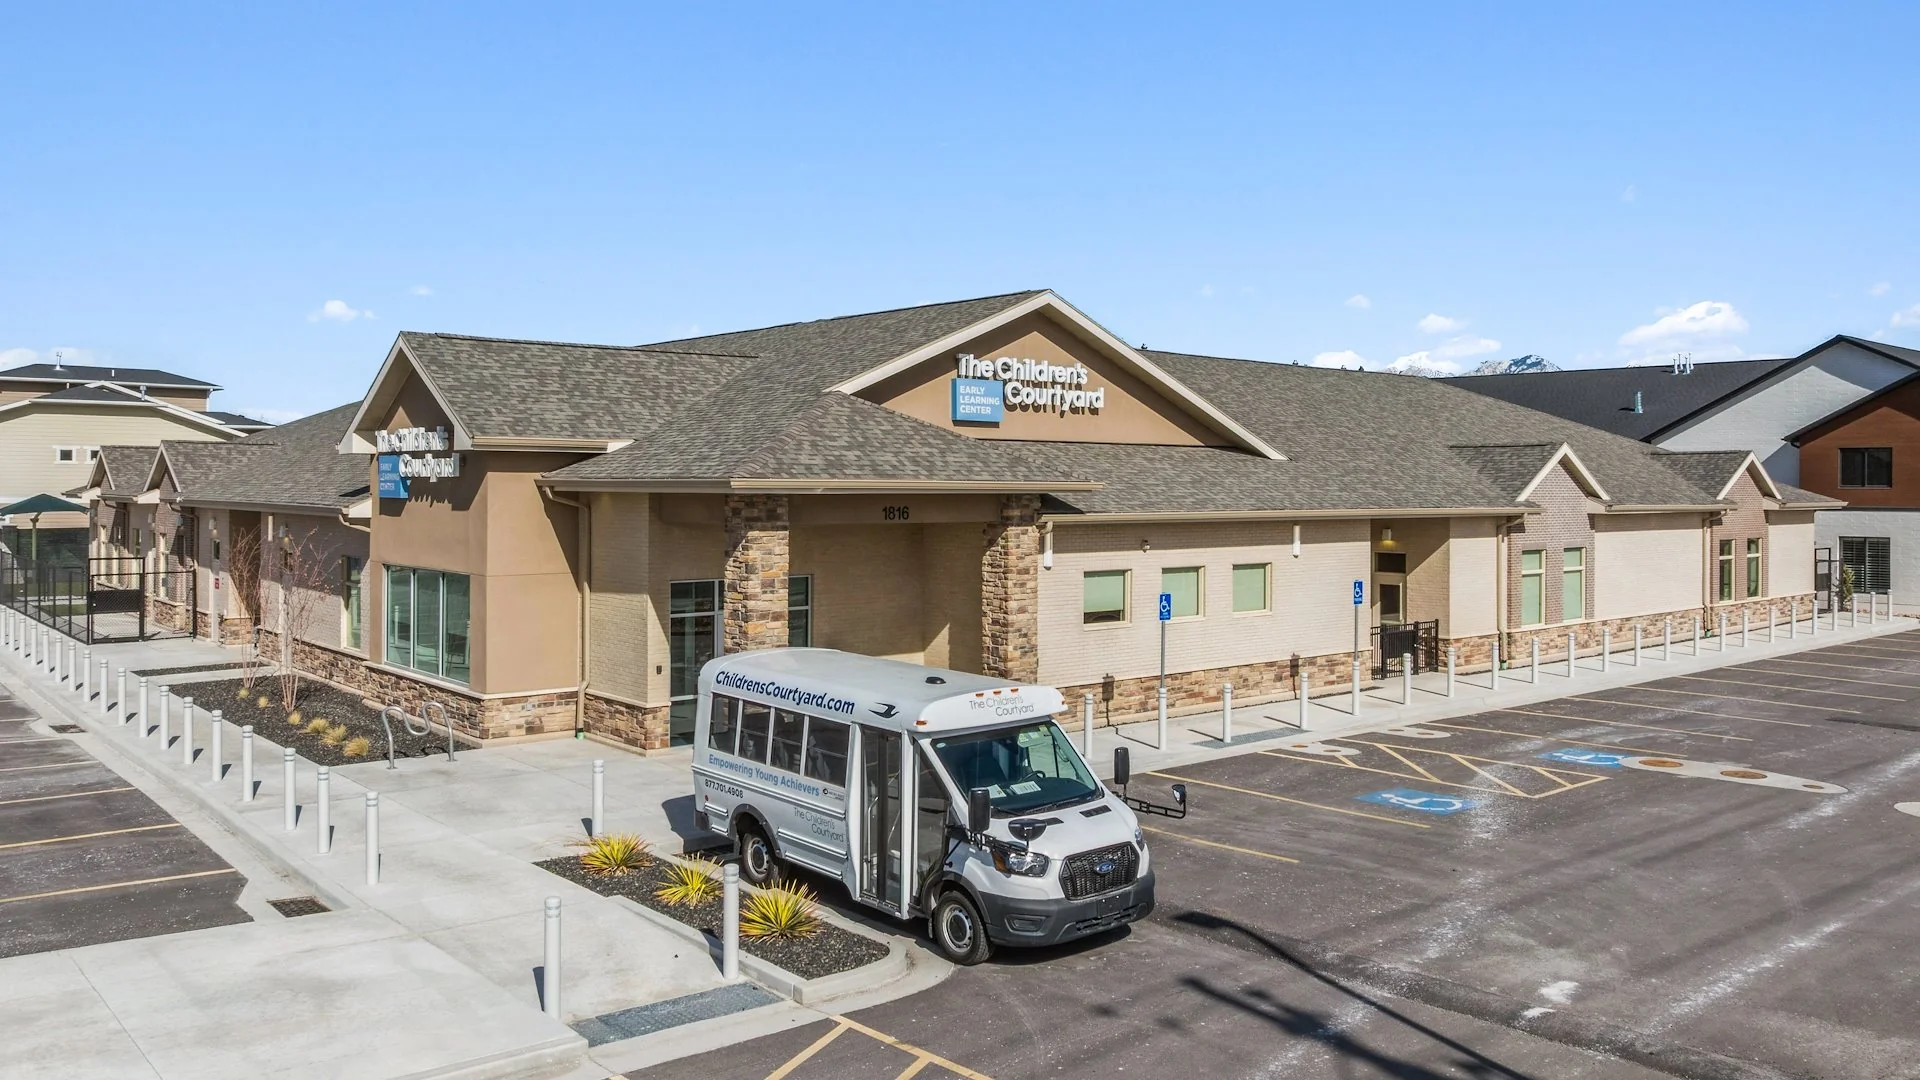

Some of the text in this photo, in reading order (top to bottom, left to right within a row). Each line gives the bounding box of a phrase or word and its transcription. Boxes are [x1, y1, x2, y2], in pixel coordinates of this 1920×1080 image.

[957, 353, 1088, 384] The Children's
[959, 385, 985, 395] EARLY
[959, 395, 1000, 405] LEARNING
[1005, 382, 1105, 411] Courtyard
[959, 405, 991, 415] CENTER
[882, 506, 909, 520] 1816
[715, 670, 855, 715] ChildrensCourtyard.com
[969, 696, 1024, 710] The Children's
[995, 704, 1034, 717] Courtyard
[708, 753, 753, 778] Empowering
[755, 767, 779, 786] Young
[780, 775, 820, 797] Achievers
[704, 778, 744, 799] 877.701.4908
[794, 807, 836, 830] The Children's
[811, 823, 844, 843] Courtyard
